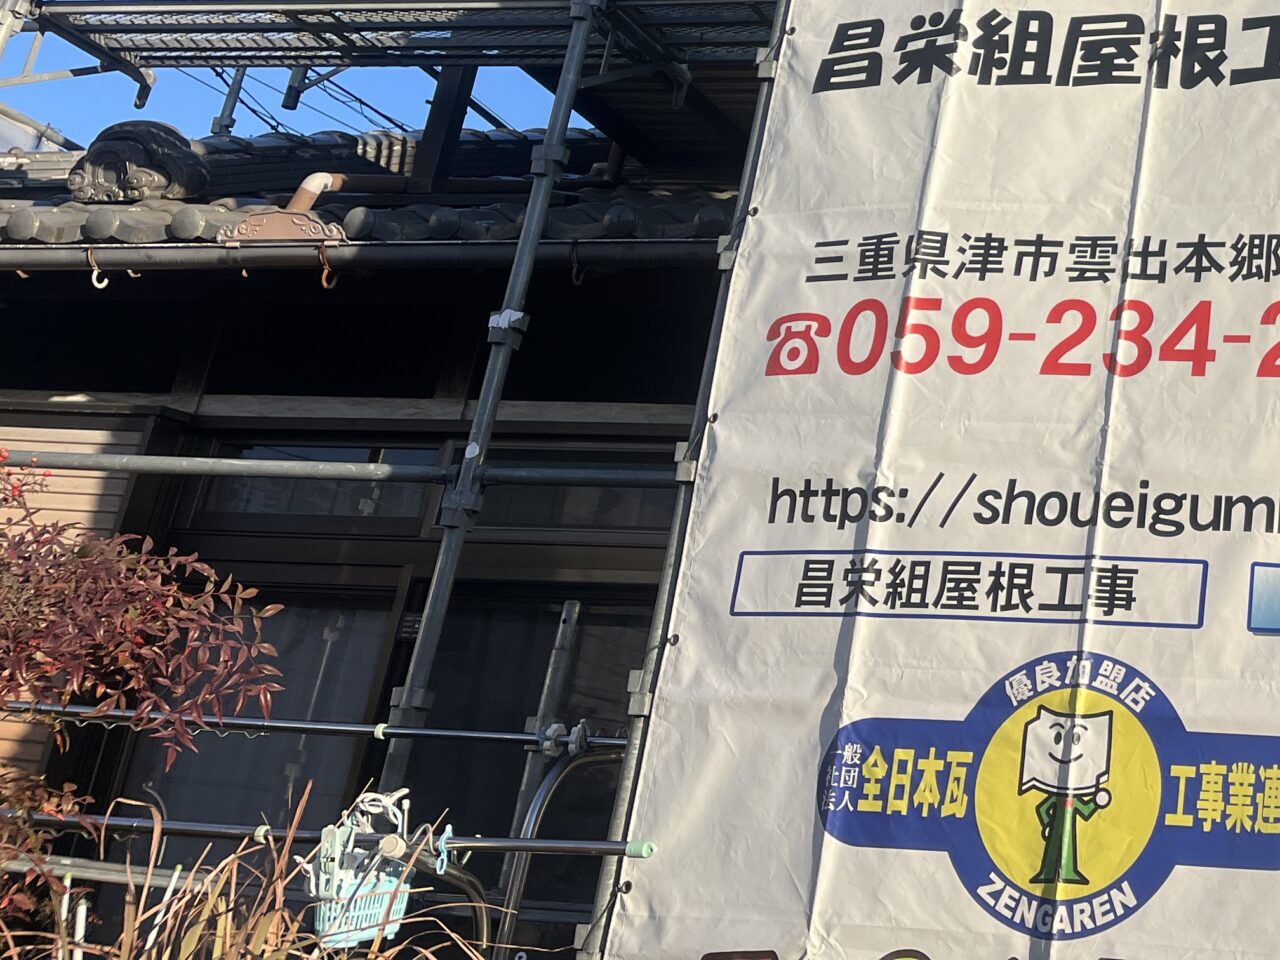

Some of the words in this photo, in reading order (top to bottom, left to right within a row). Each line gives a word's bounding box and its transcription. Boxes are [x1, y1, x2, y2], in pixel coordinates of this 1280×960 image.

[795, 558, 1139, 616] 昌栄組屋根工事
[1004, 655, 1156, 714] 優良加盟店
[857, 745, 974, 818] 全日本瓦
[977, 872, 1138, 933] ZENGAREN
